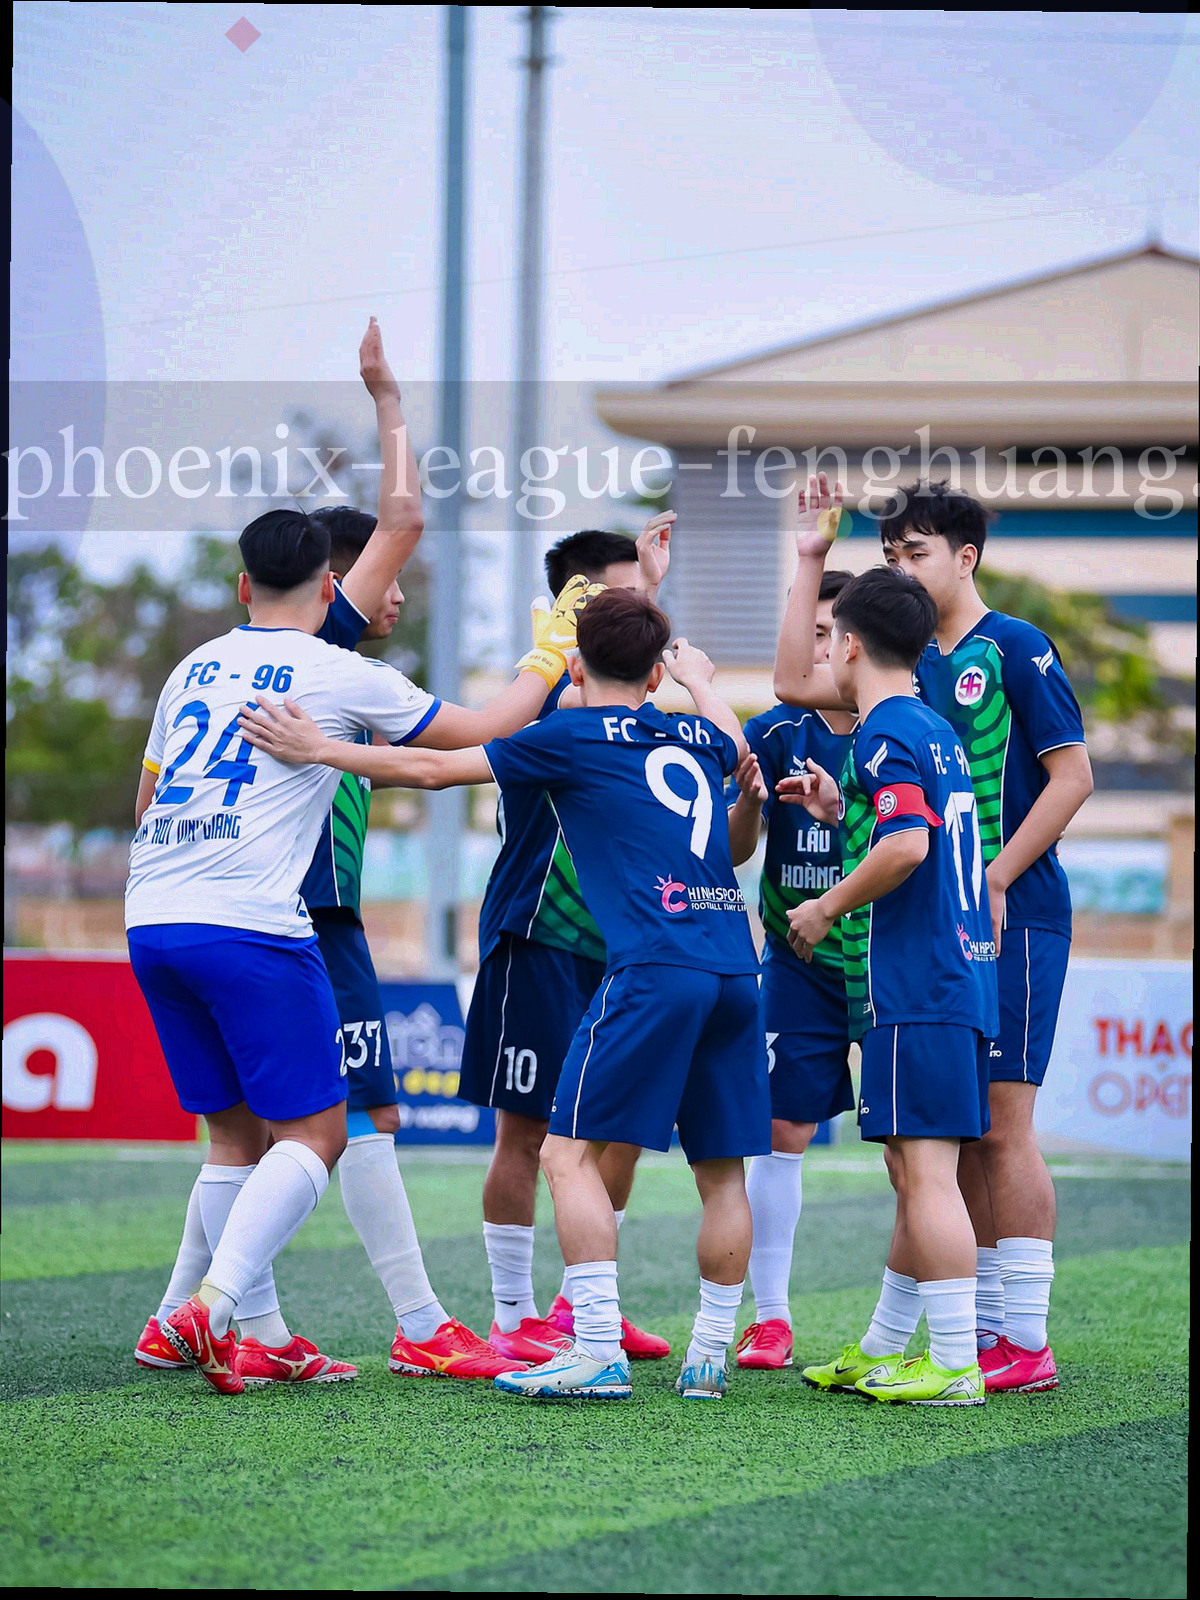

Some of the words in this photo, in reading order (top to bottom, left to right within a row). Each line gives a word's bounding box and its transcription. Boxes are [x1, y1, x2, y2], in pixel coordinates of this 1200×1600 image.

[184, 661, 220, 689] FC
[251, 664, 294, 693] 96
[602, 716, 638, 742] FC
[154, 700, 258, 807] 24
[644, 745, 713, 860] 9
[797, 822, 831, 852] LẨU
[943, 791, 982, 911] 17
[781, 861, 840, 889] HOÀNG
[504, 1046, 537, 1094] 10
